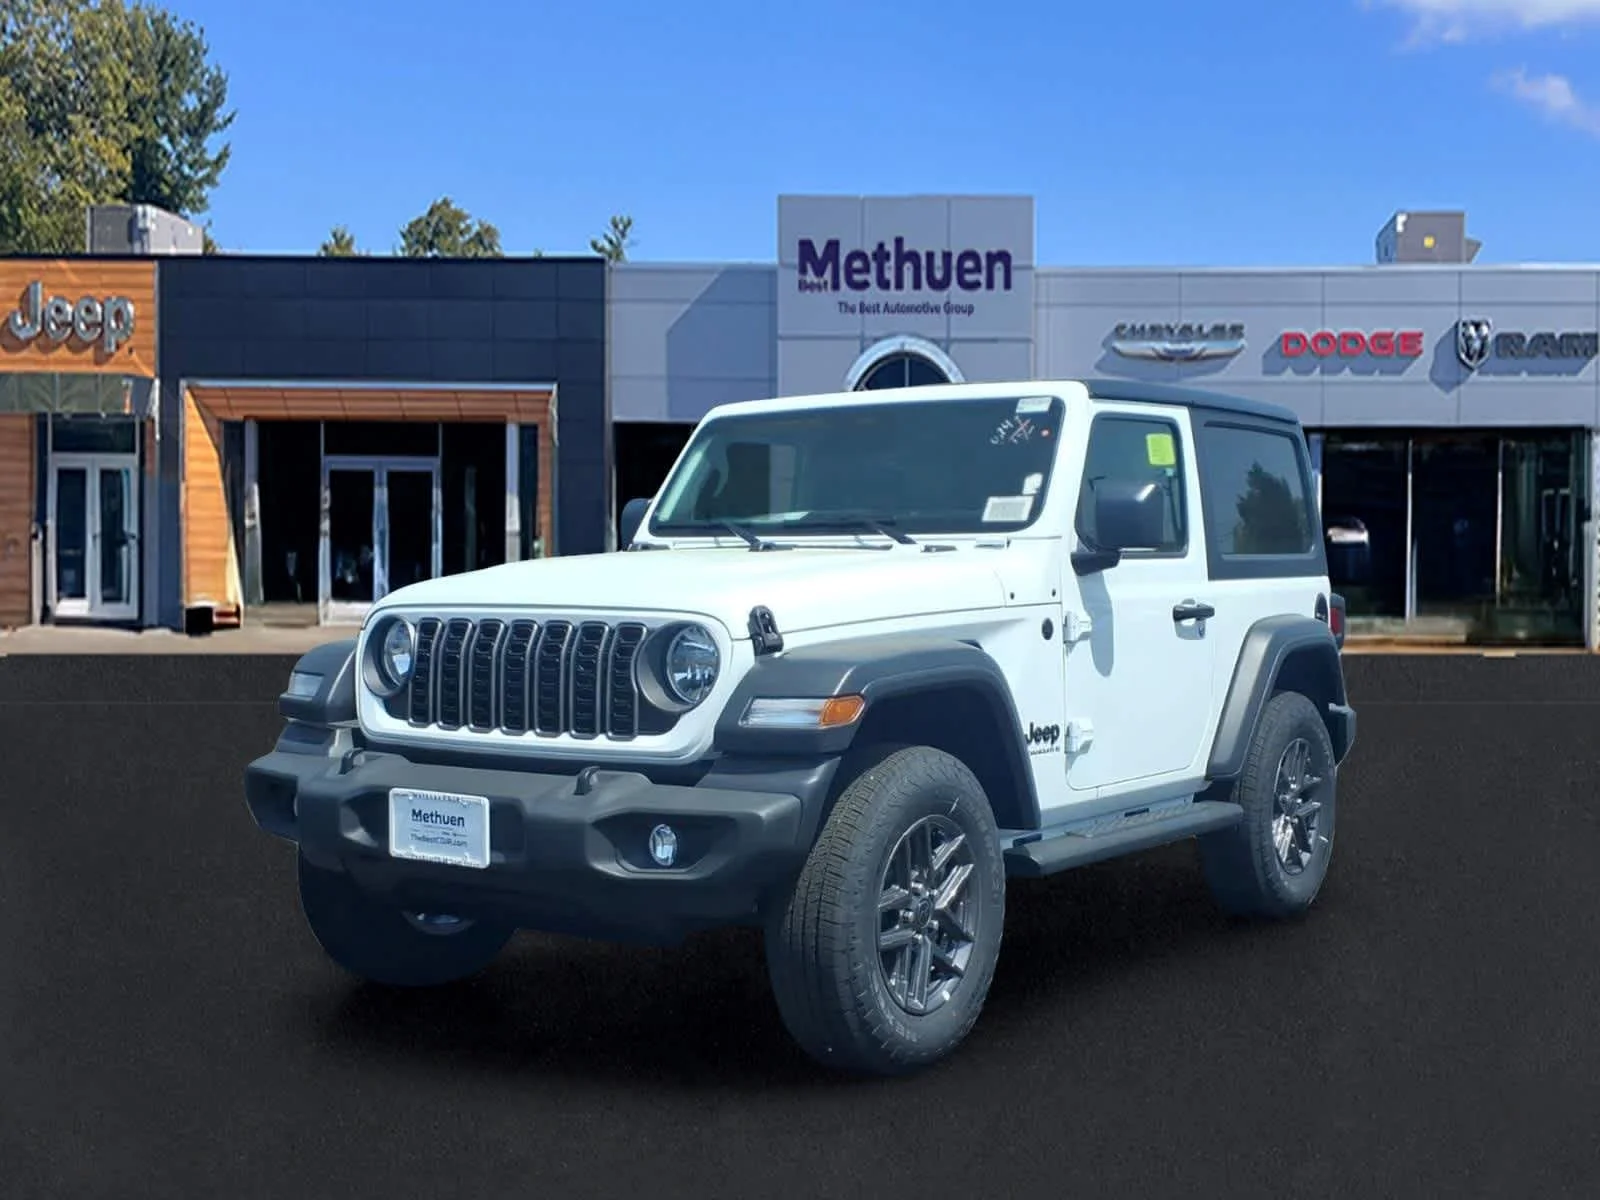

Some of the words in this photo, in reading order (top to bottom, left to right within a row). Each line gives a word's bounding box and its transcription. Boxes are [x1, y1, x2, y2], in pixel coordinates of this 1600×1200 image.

[798, 236, 1012, 291] Methuen
[9, 280, 135, 354] Jeep
[838, 301, 856, 314] The
[859, 301, 881, 314] Best
[883, 301, 941, 315] Automotive
[943, 302, 975, 316] Group
[1281, 331, 1424, 357] DODGE
[1495, 332, 1598, 359] RAM
[1024, 722, 1060, 745] Jeep
[411, 808, 465, 827] Methuen
